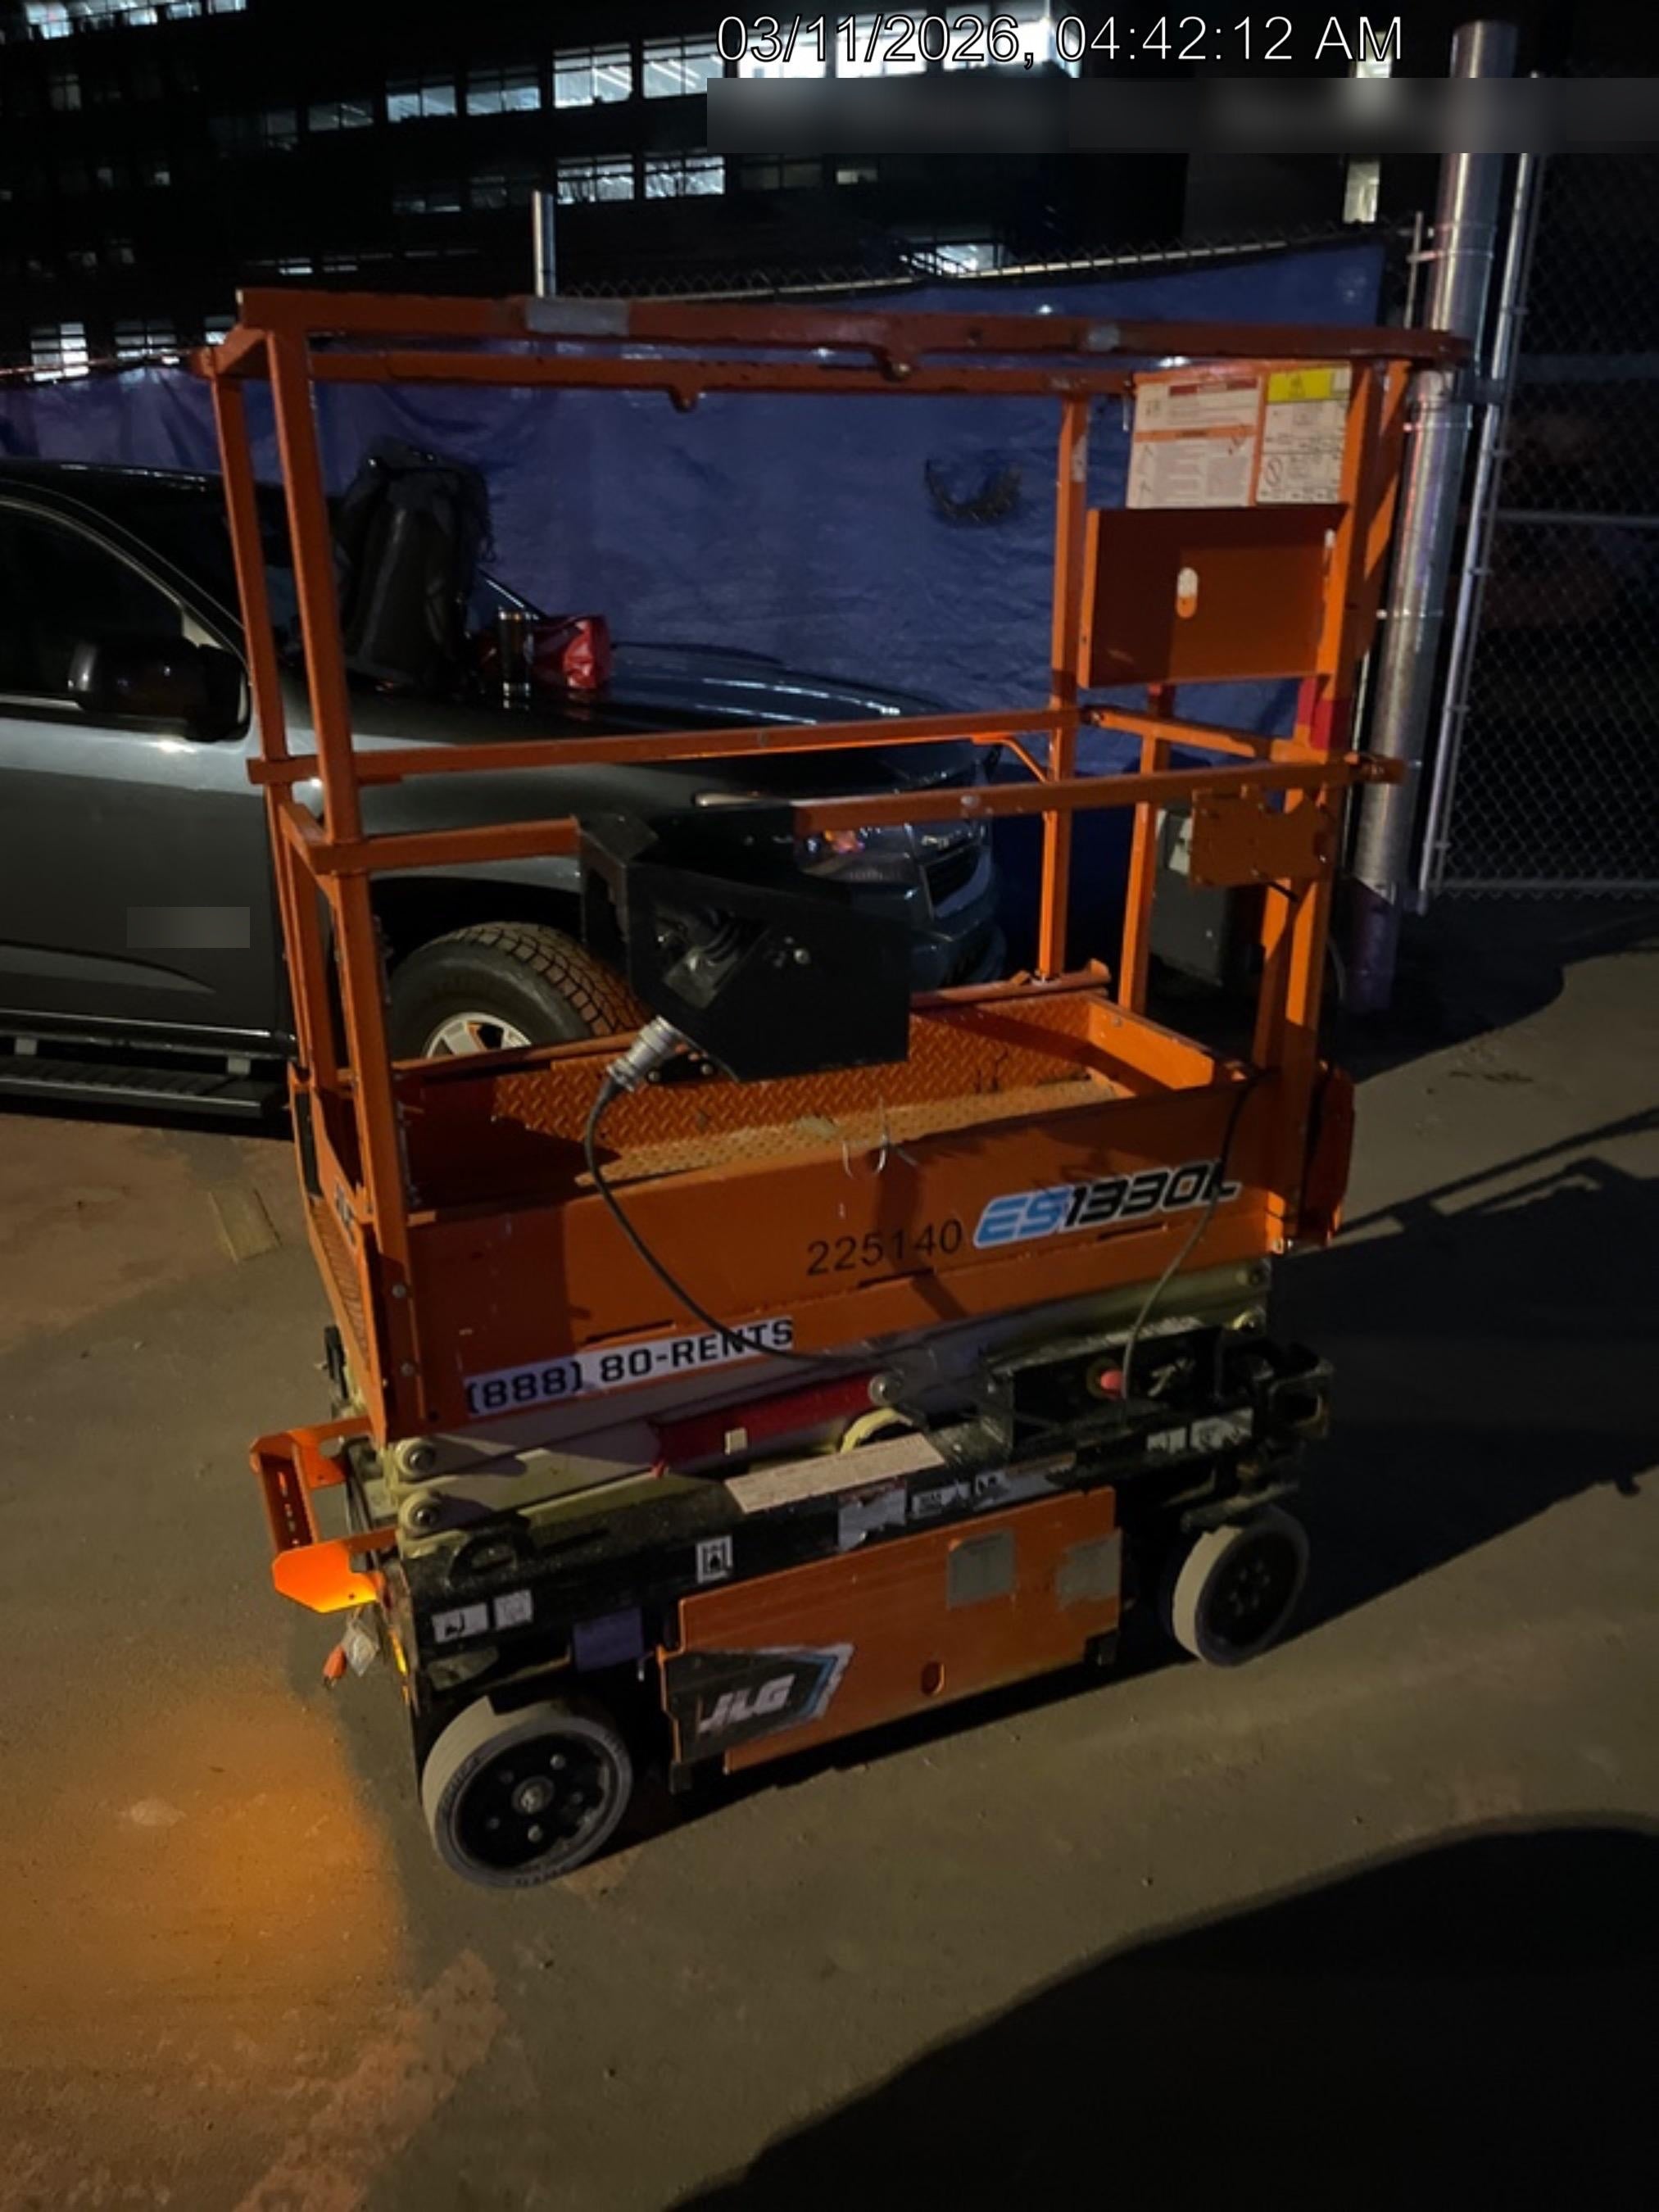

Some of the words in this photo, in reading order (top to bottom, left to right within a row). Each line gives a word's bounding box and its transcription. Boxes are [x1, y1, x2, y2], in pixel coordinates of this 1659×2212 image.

[975, 1160, 1240, 1247] ES1330L
[807, 1220, 961, 1275] 225140
[468, 1361, 582, 1414] (888)
[601, 1319, 793, 1383] 80-RENTS
[699, 1673, 795, 1732] JLG
